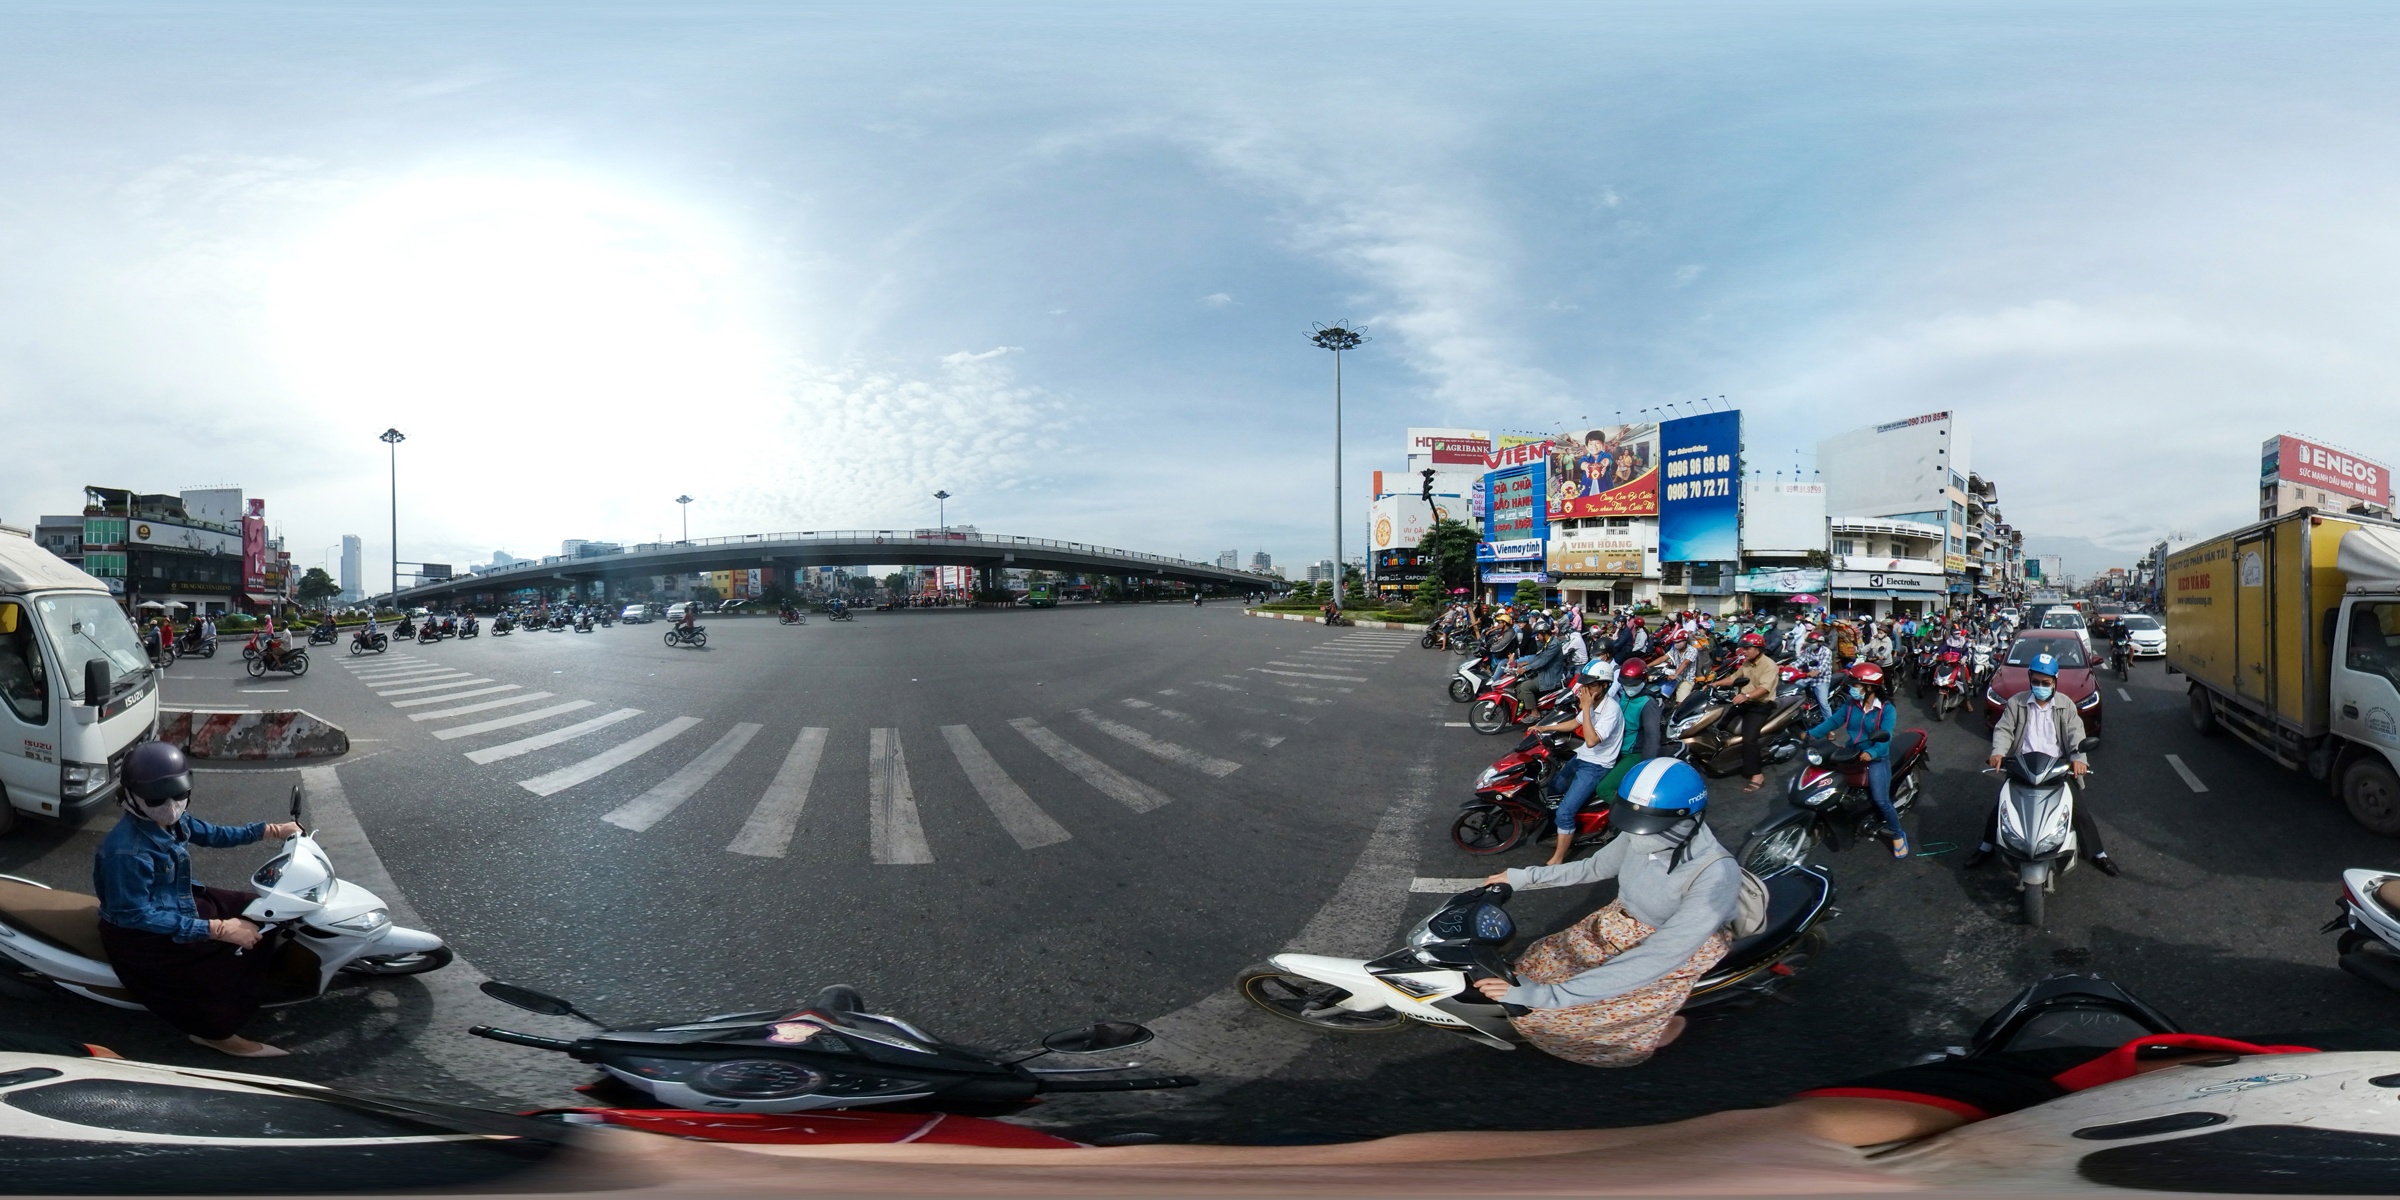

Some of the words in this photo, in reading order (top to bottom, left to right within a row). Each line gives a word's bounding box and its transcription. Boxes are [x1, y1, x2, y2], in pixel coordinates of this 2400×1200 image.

[1445, 444, 1489, 453] AGRIBANK
[1677, 445, 1708, 455] Advertising
[1667, 459, 1688, 479] 0996
[1690, 457, 1701, 475] 96
[1703, 455, 1715, 473] 66
[1717, 454, 1730, 472] 96
[2313, 448, 2377, 484] ENEOS
[2311, 471, 2329, 482] MẠNH
[1512, 476, 1532, 491] CHỮA
[1667, 481, 1688, 501] 0908
[1690, 480, 1701, 498] 70
[1703, 479, 1715, 497] 72
[1717, 477, 1729, 496] 71
[1511, 494, 1533, 508] HÀNH
[1496, 541, 1540, 556] Vienmaytinh
[1571, 541, 1595, 549] VINH
[1886, 578, 1921, 586] Electrolux
[125, 689, 144, 707] ISUZU
[24, 740, 52, 751] ISUZU
[1406, 1012, 1456, 1023] AMAHA
